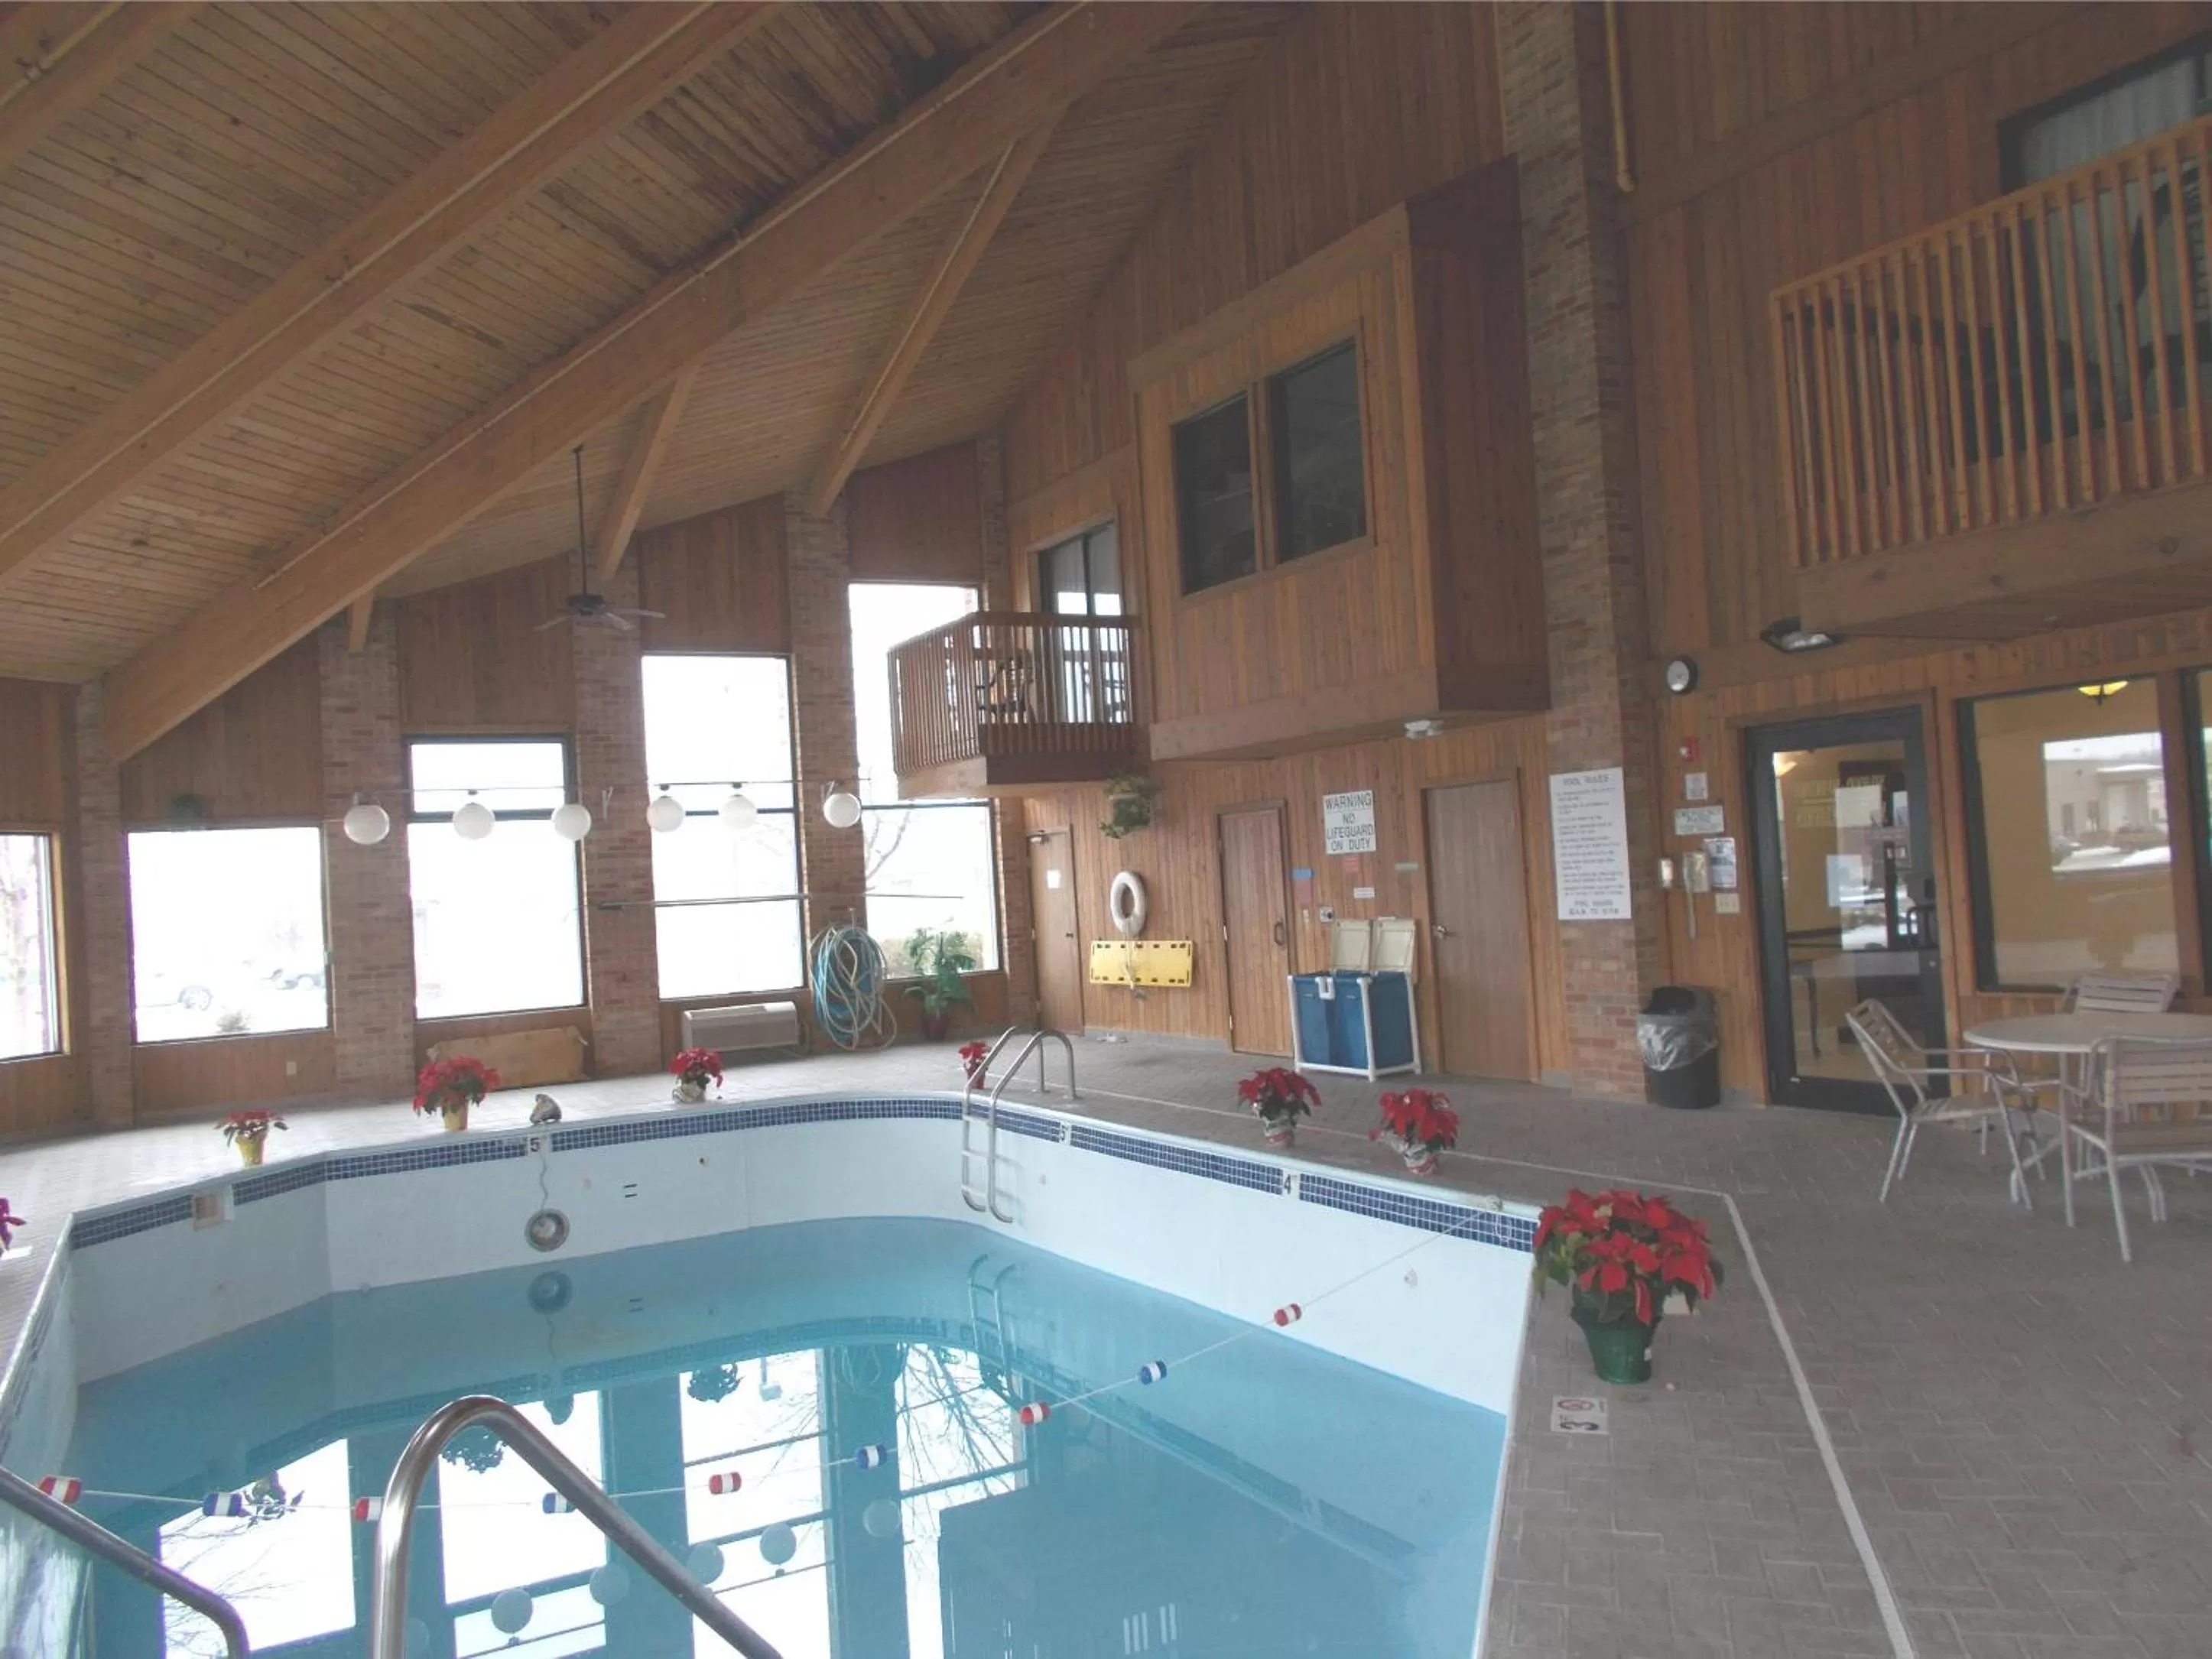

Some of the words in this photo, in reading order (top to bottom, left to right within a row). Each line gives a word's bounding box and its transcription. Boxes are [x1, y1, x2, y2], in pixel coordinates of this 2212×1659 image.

[1326, 793, 1372, 810] WARNING
[1343, 813, 1356, 825] NO
[1327, 824, 1374, 840] LIFEGUARD
[1331, 840, 1343, 851] ON
[1349, 838, 1371, 850] DUTY
[531, 1137, 541, 1152] 5
[1284, 1174, 1291, 1195] 4
